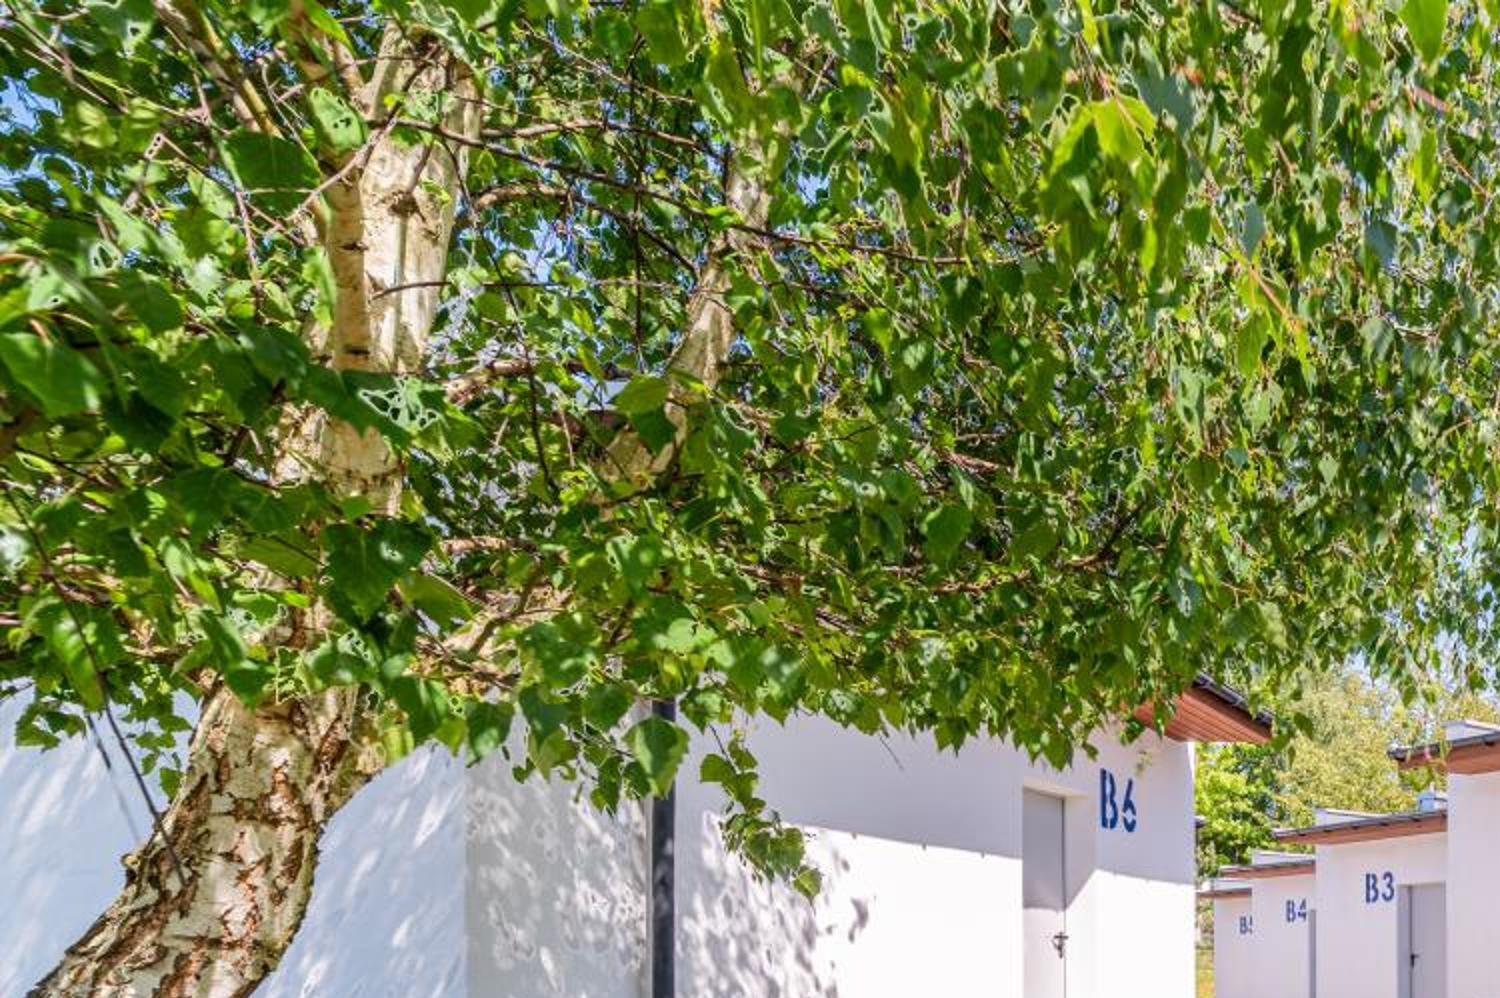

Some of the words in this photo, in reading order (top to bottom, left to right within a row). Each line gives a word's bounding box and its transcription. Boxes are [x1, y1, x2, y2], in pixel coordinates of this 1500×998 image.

[1099, 768, 1137, 833] B6
[1365, 871, 1396, 905] B3
[1285, 899, 1308, 923] B4
